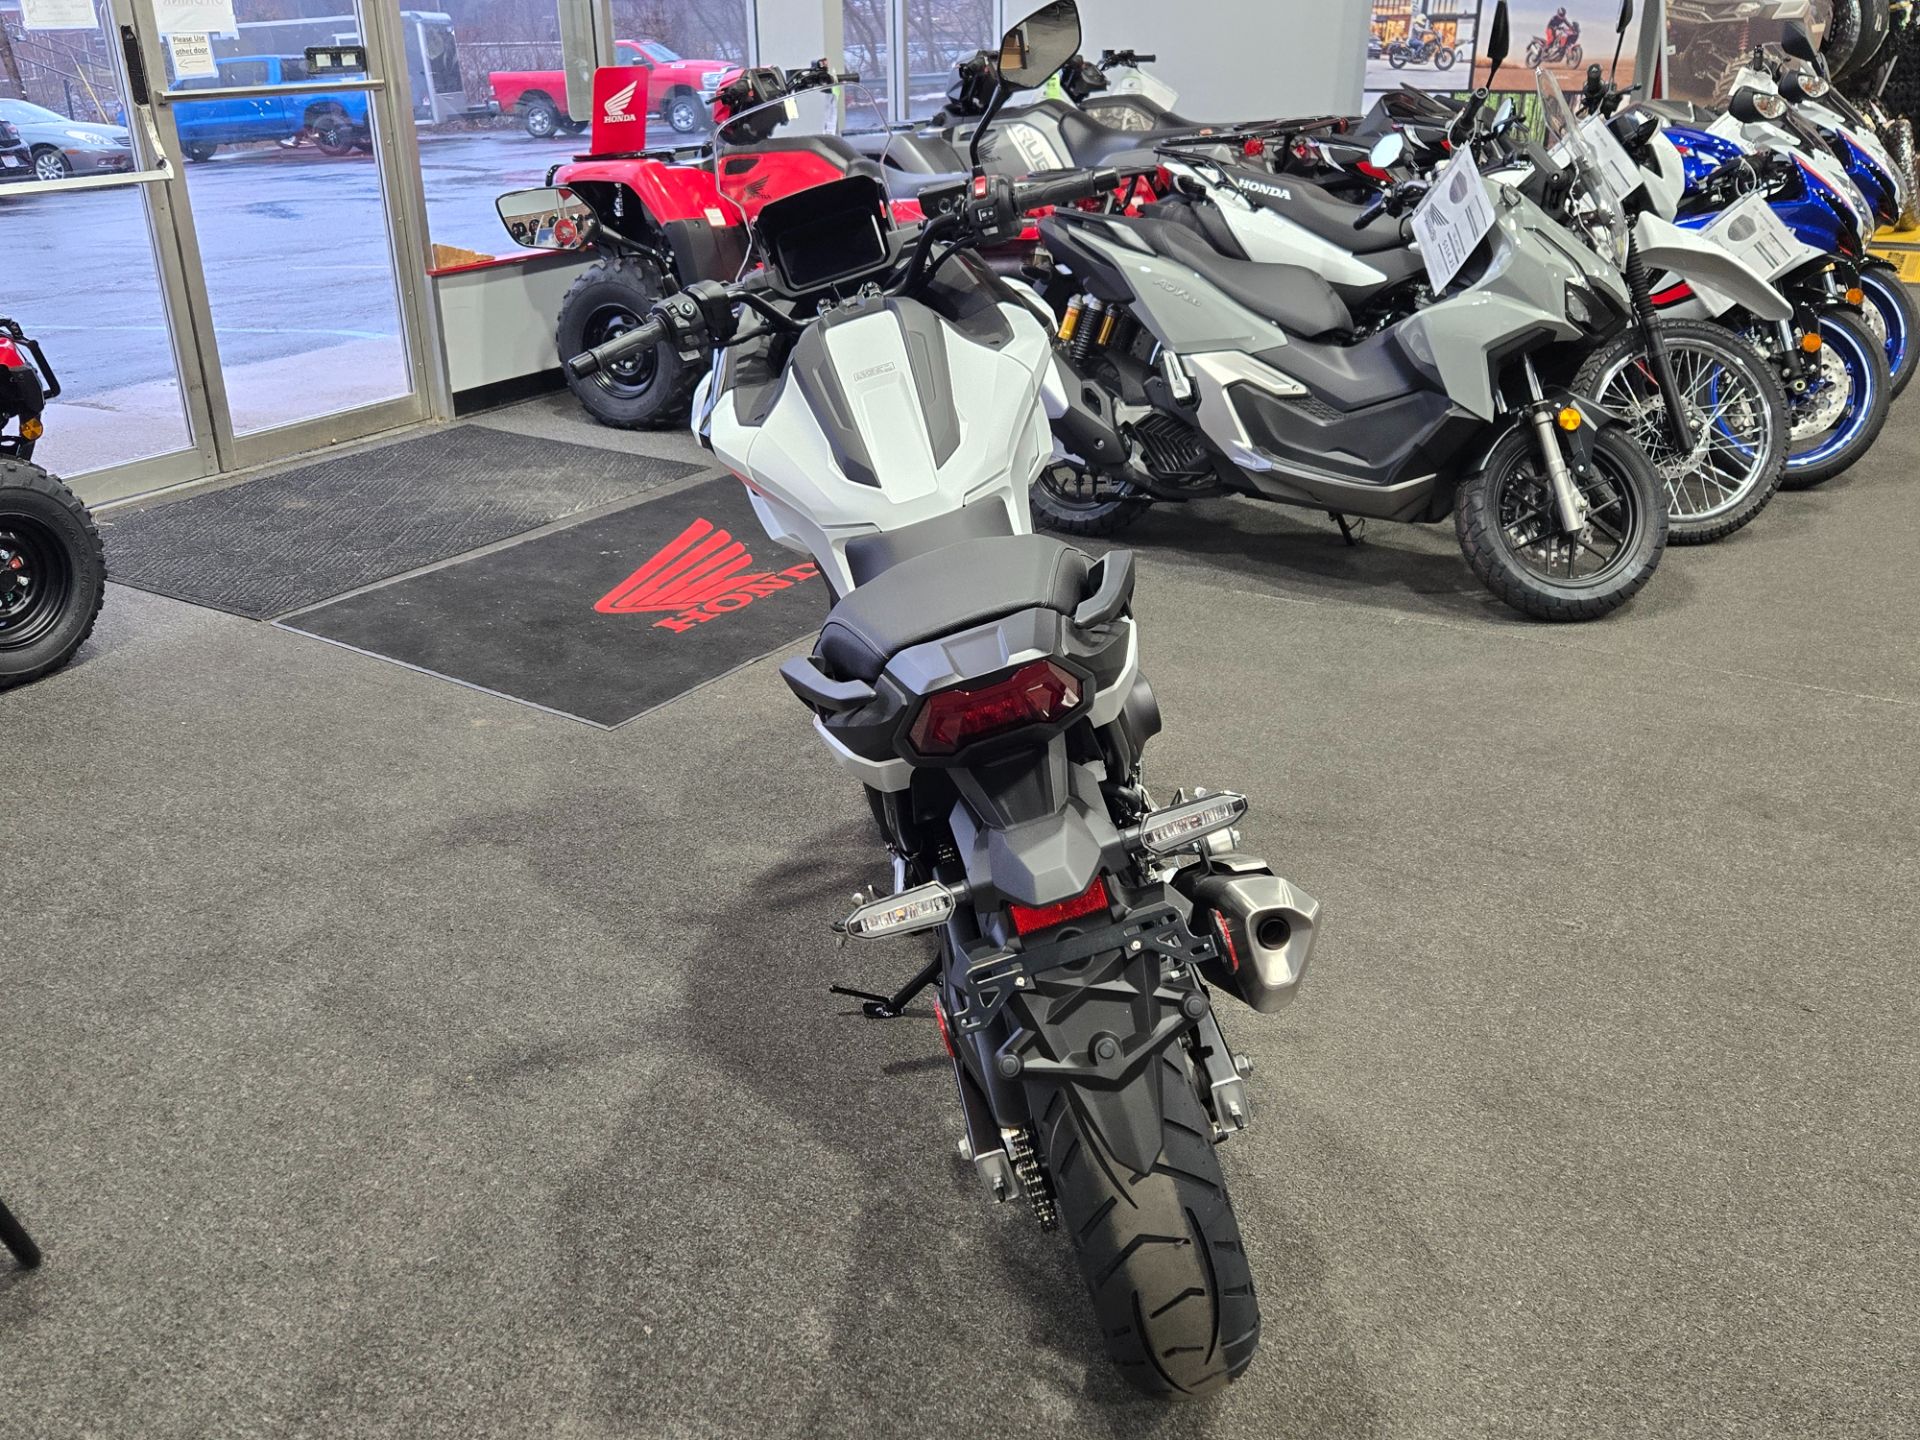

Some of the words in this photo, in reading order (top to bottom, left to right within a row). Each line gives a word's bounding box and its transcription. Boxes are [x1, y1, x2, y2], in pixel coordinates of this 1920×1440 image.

[194, 34, 206, 42] Use
[176, 47, 193, 55] other
[603, 114, 637, 123] HONDA
[1239, 178, 1292, 200] HONDA
[652, 562, 821, 633] HOND
